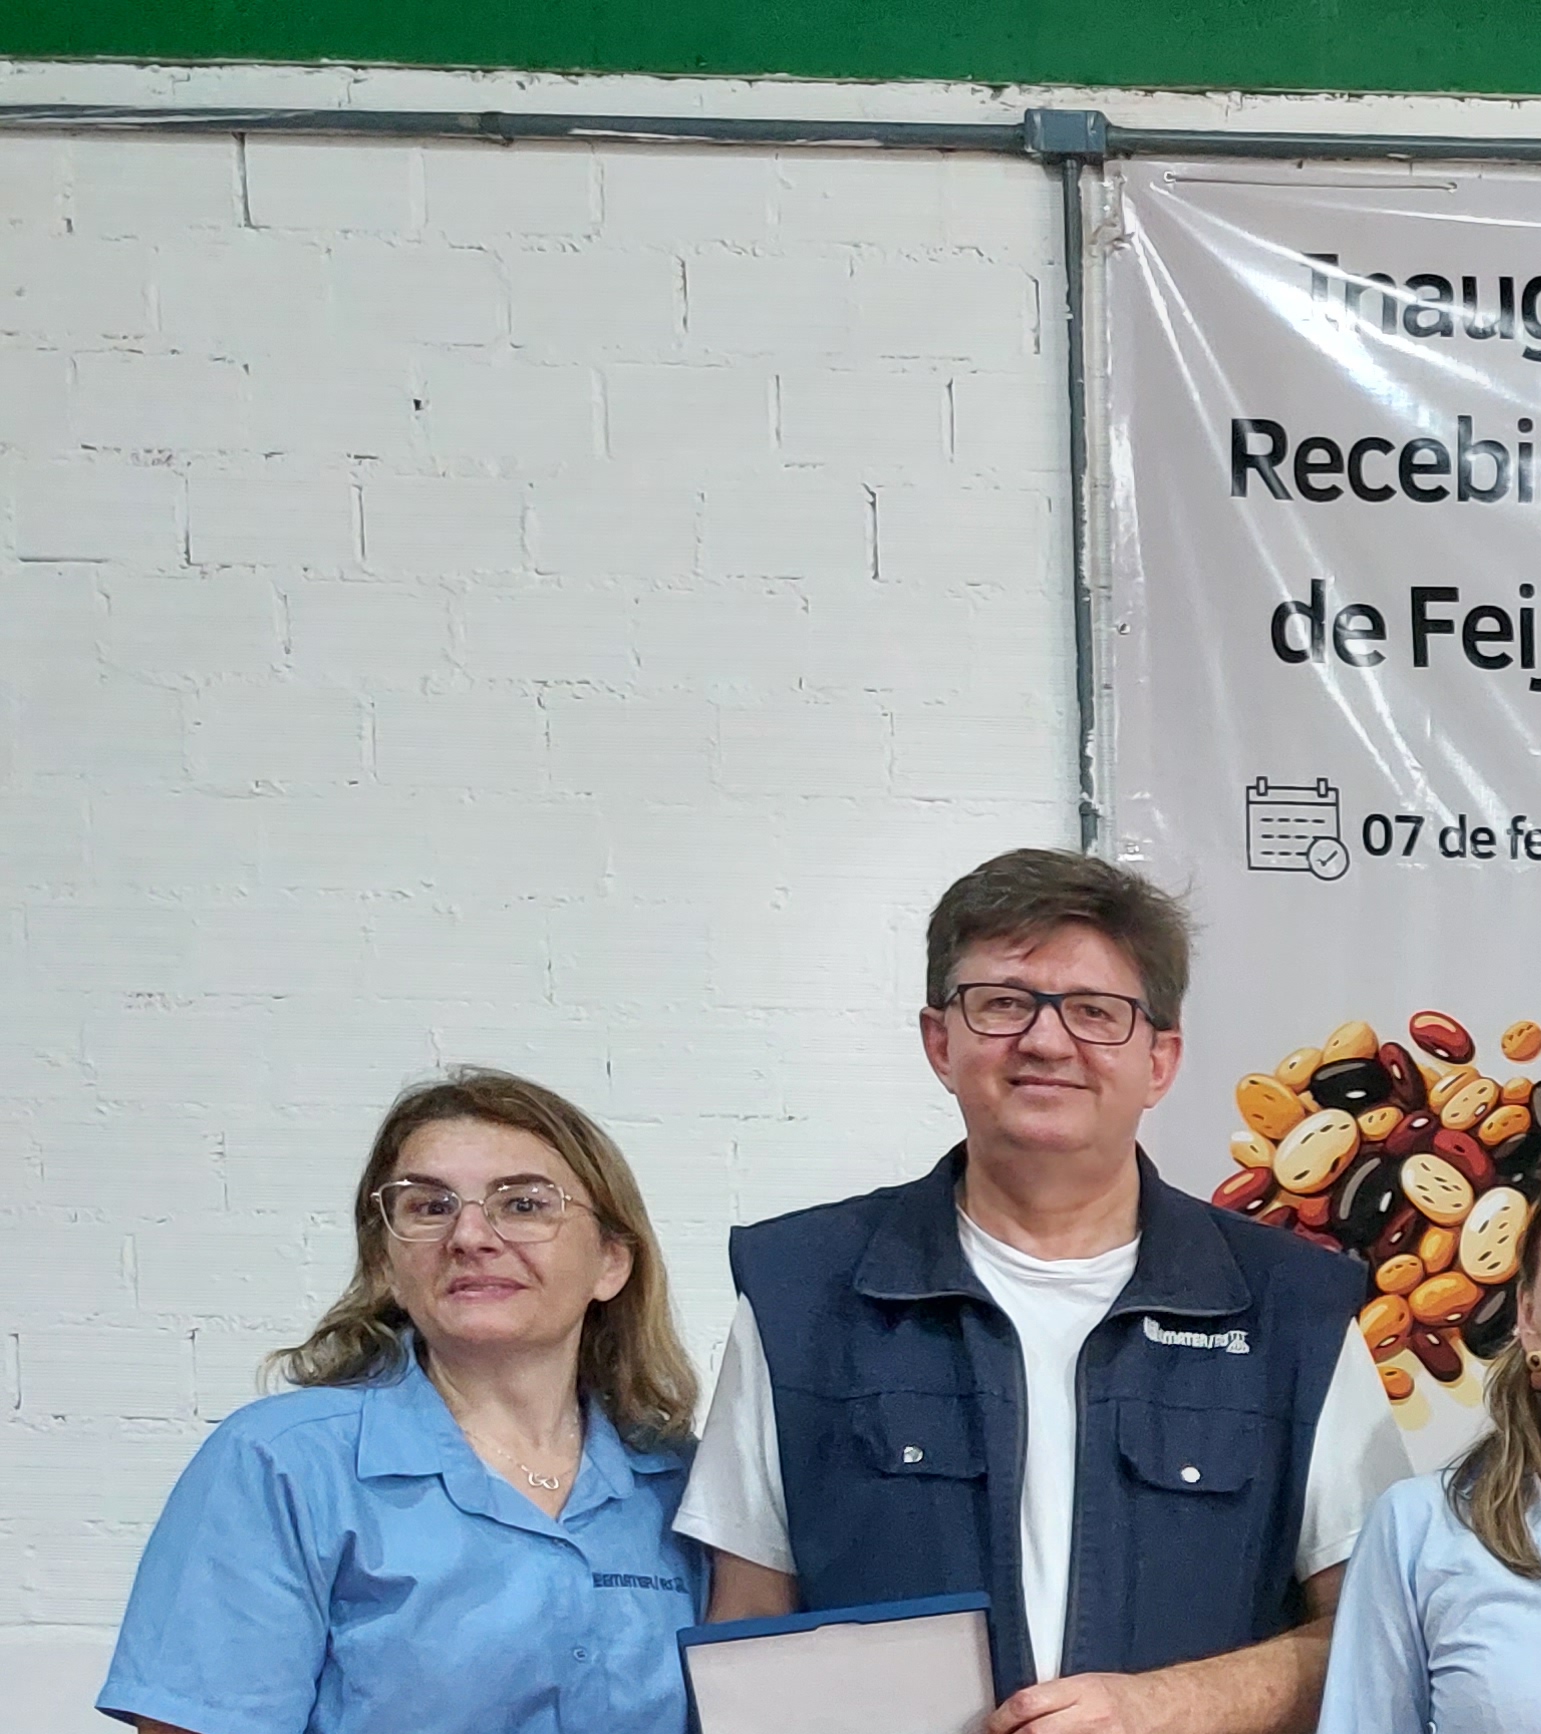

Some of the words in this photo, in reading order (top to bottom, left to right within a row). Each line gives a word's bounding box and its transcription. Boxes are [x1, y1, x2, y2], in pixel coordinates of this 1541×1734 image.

[1271, 578, 1386, 667] de
[1362, 813, 1423, 857] 07
[1438, 815, 1496, 860] de
